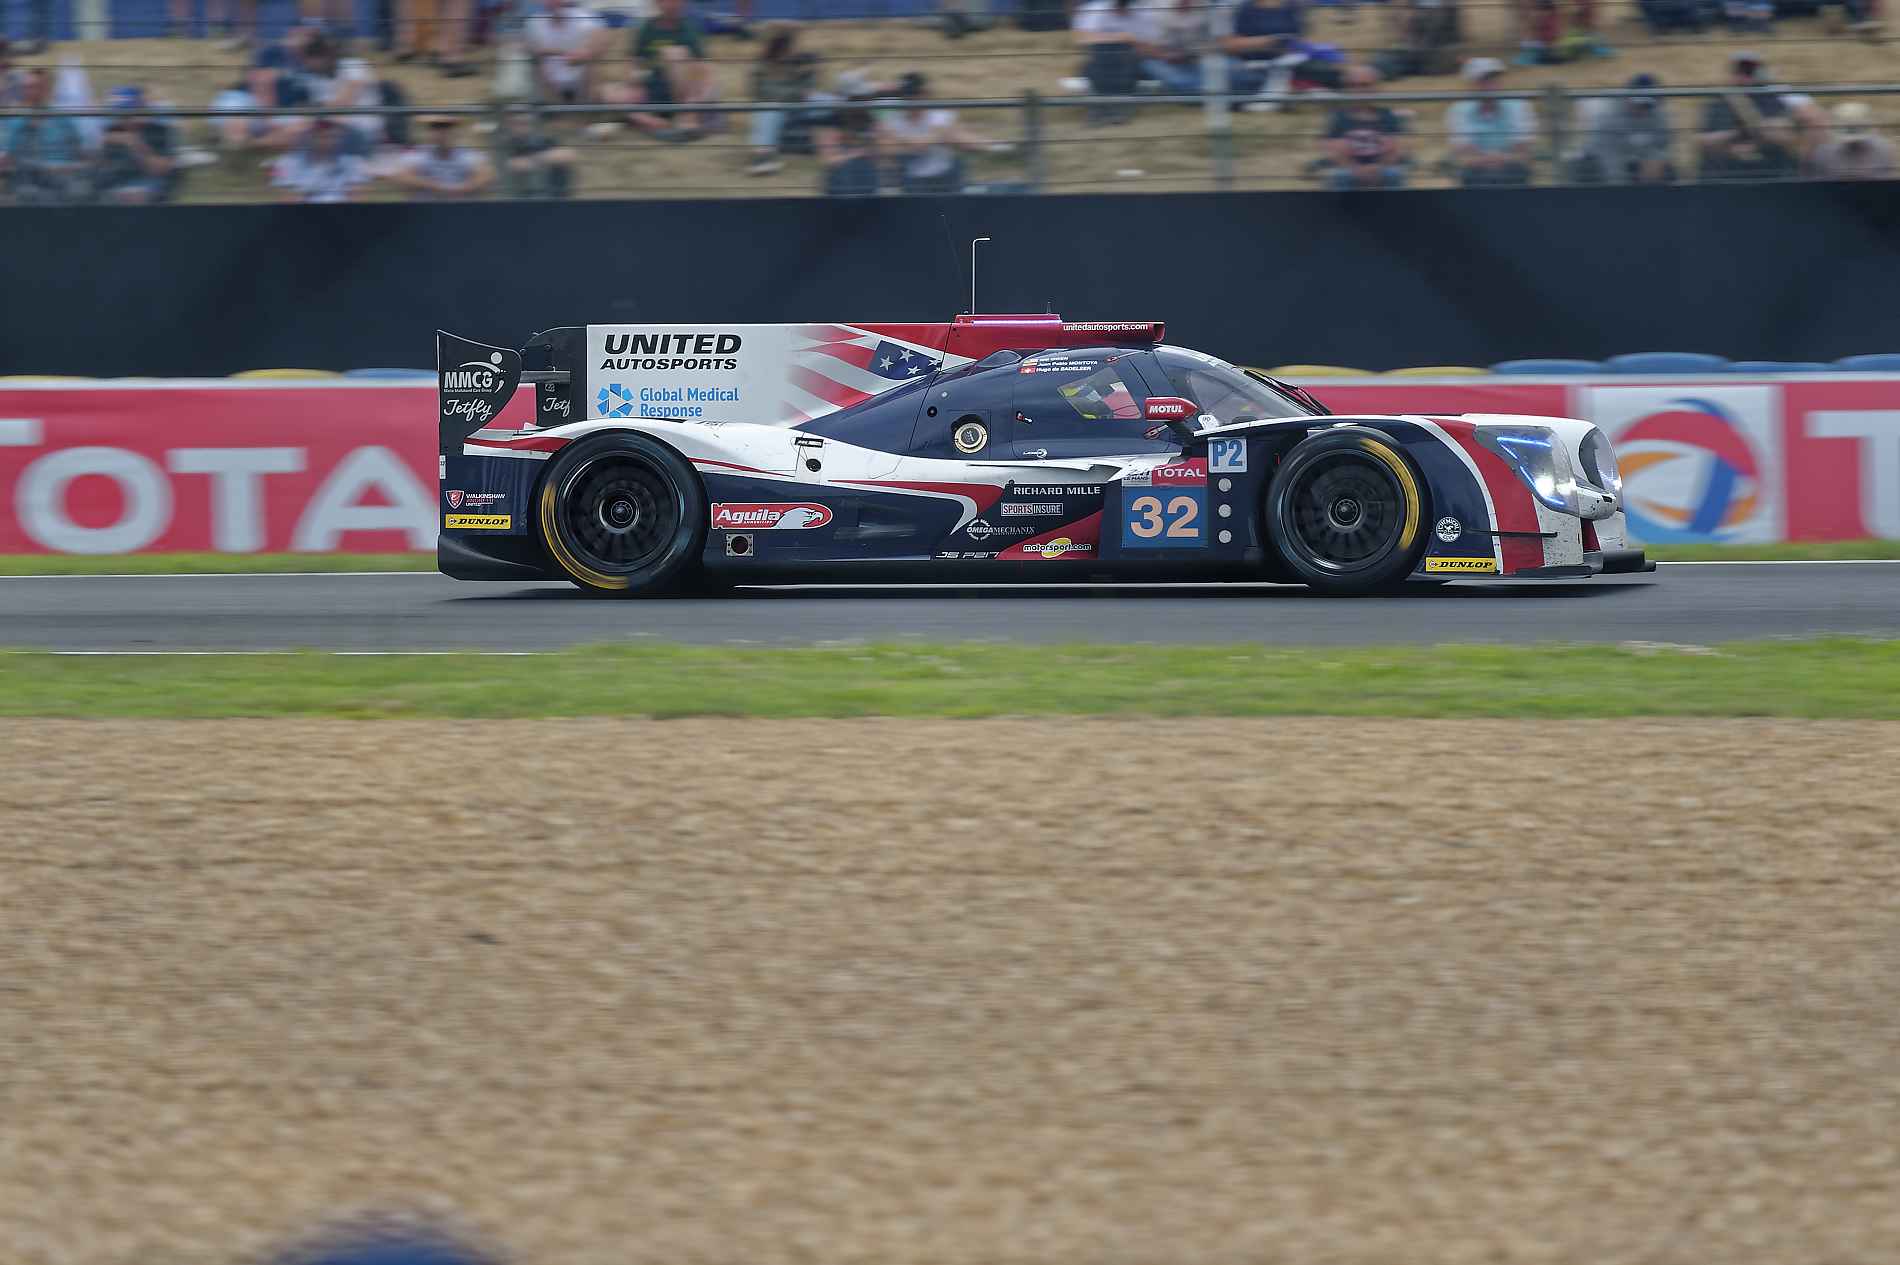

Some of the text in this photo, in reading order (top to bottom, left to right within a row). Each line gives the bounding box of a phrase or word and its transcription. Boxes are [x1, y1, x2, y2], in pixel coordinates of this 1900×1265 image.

[1063, 323, 1148, 332] unitedautosports.com
[604, 334, 742, 354] UNITED
[600, 358, 737, 370] AUTOSPORTS
[444, 371, 493, 388] MMCG
[640, 387, 739, 402] Global Medical
[443, 399, 493, 421] Jetfly
[640, 403, 702, 418] Response
[1149, 405, 1184, 414] MOTUL
[1212, 440, 1243, 468] P2
[1156, 468, 1206, 478] TOTAL
[1013, 486, 1101, 495] RICHARD MILLE
[716, 509, 780, 524] Aguila
[1130, 496, 1199, 538] 32
[1023, 543, 1092, 553] motorsport.com
[1438, 561, 1493, 569] DUNLOP
